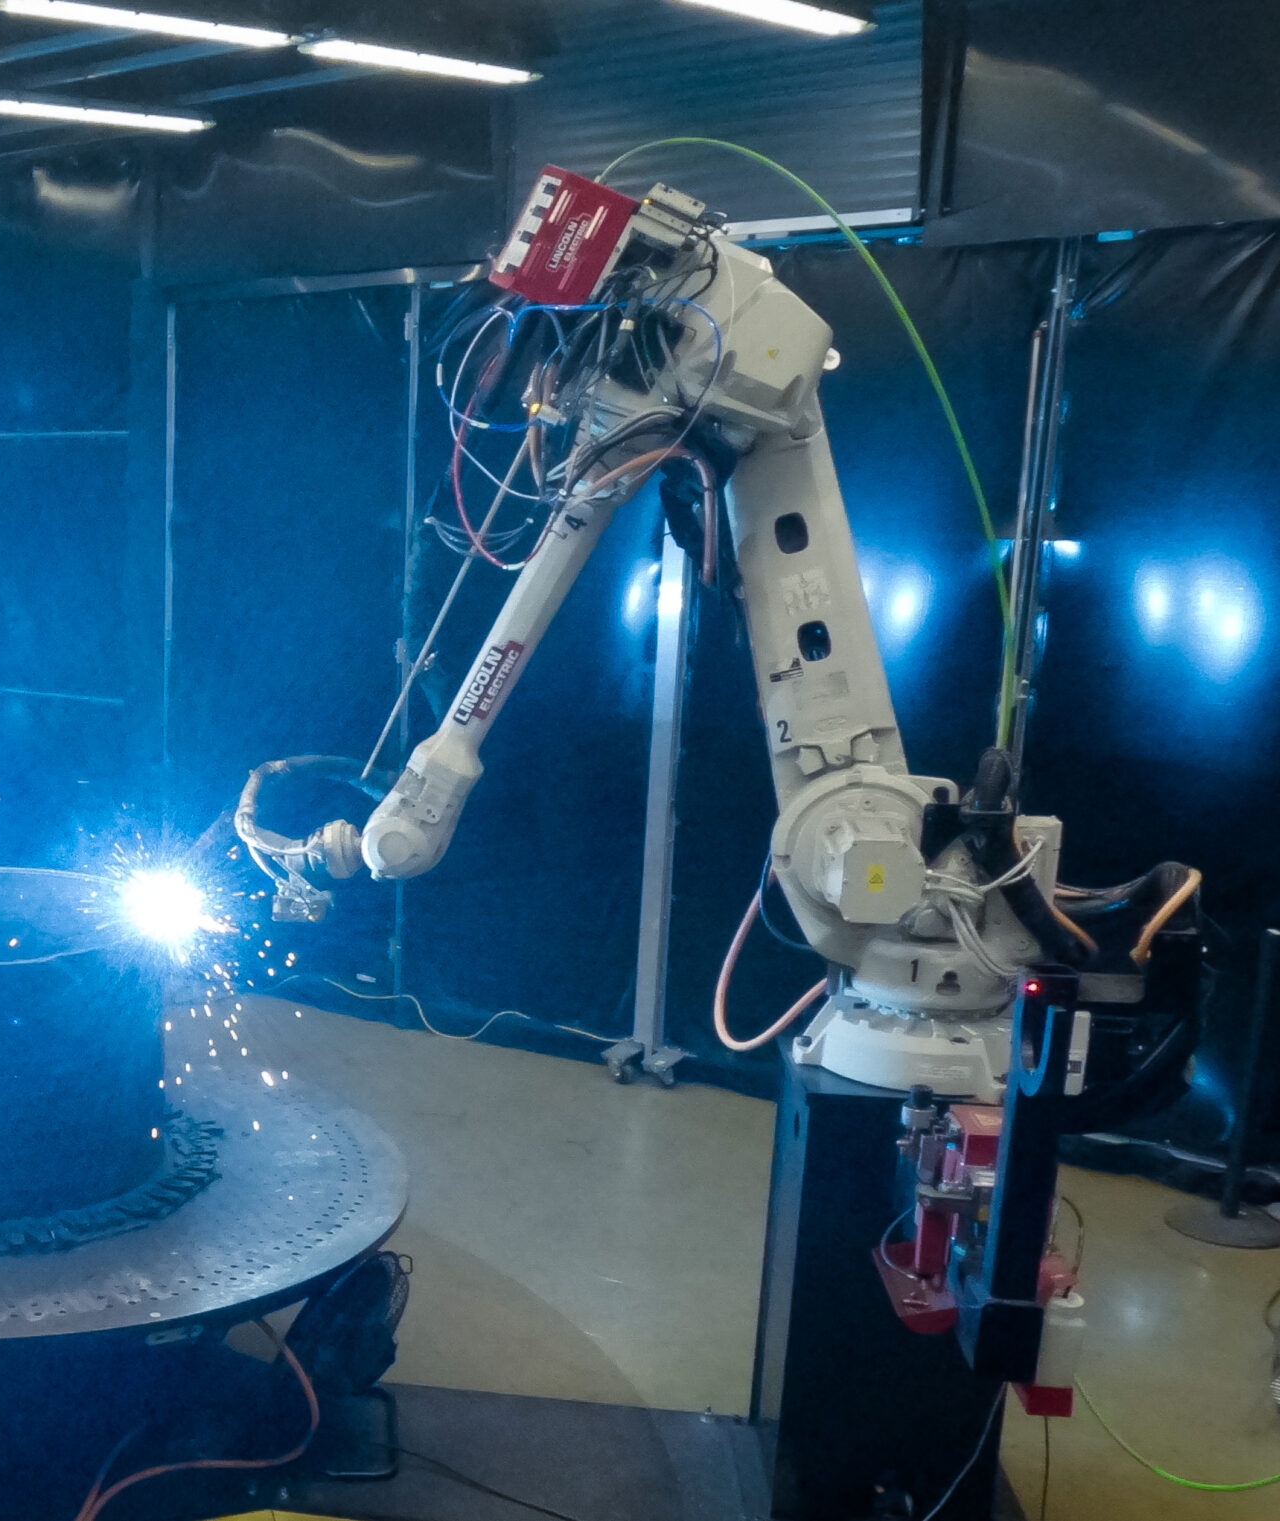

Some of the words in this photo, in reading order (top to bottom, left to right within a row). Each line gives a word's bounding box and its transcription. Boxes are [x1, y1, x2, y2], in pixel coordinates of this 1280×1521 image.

[549, 221, 578, 268] LINCOLN
[563, 220, 589, 261] ELECTRIC
[565, 514, 587, 531] 4
[455, 648, 504, 722] LINCOLN
[479, 650, 520, 712] ELECTRIC
[776, 719, 792, 743] 2
[911, 958, 919, 982] 1
